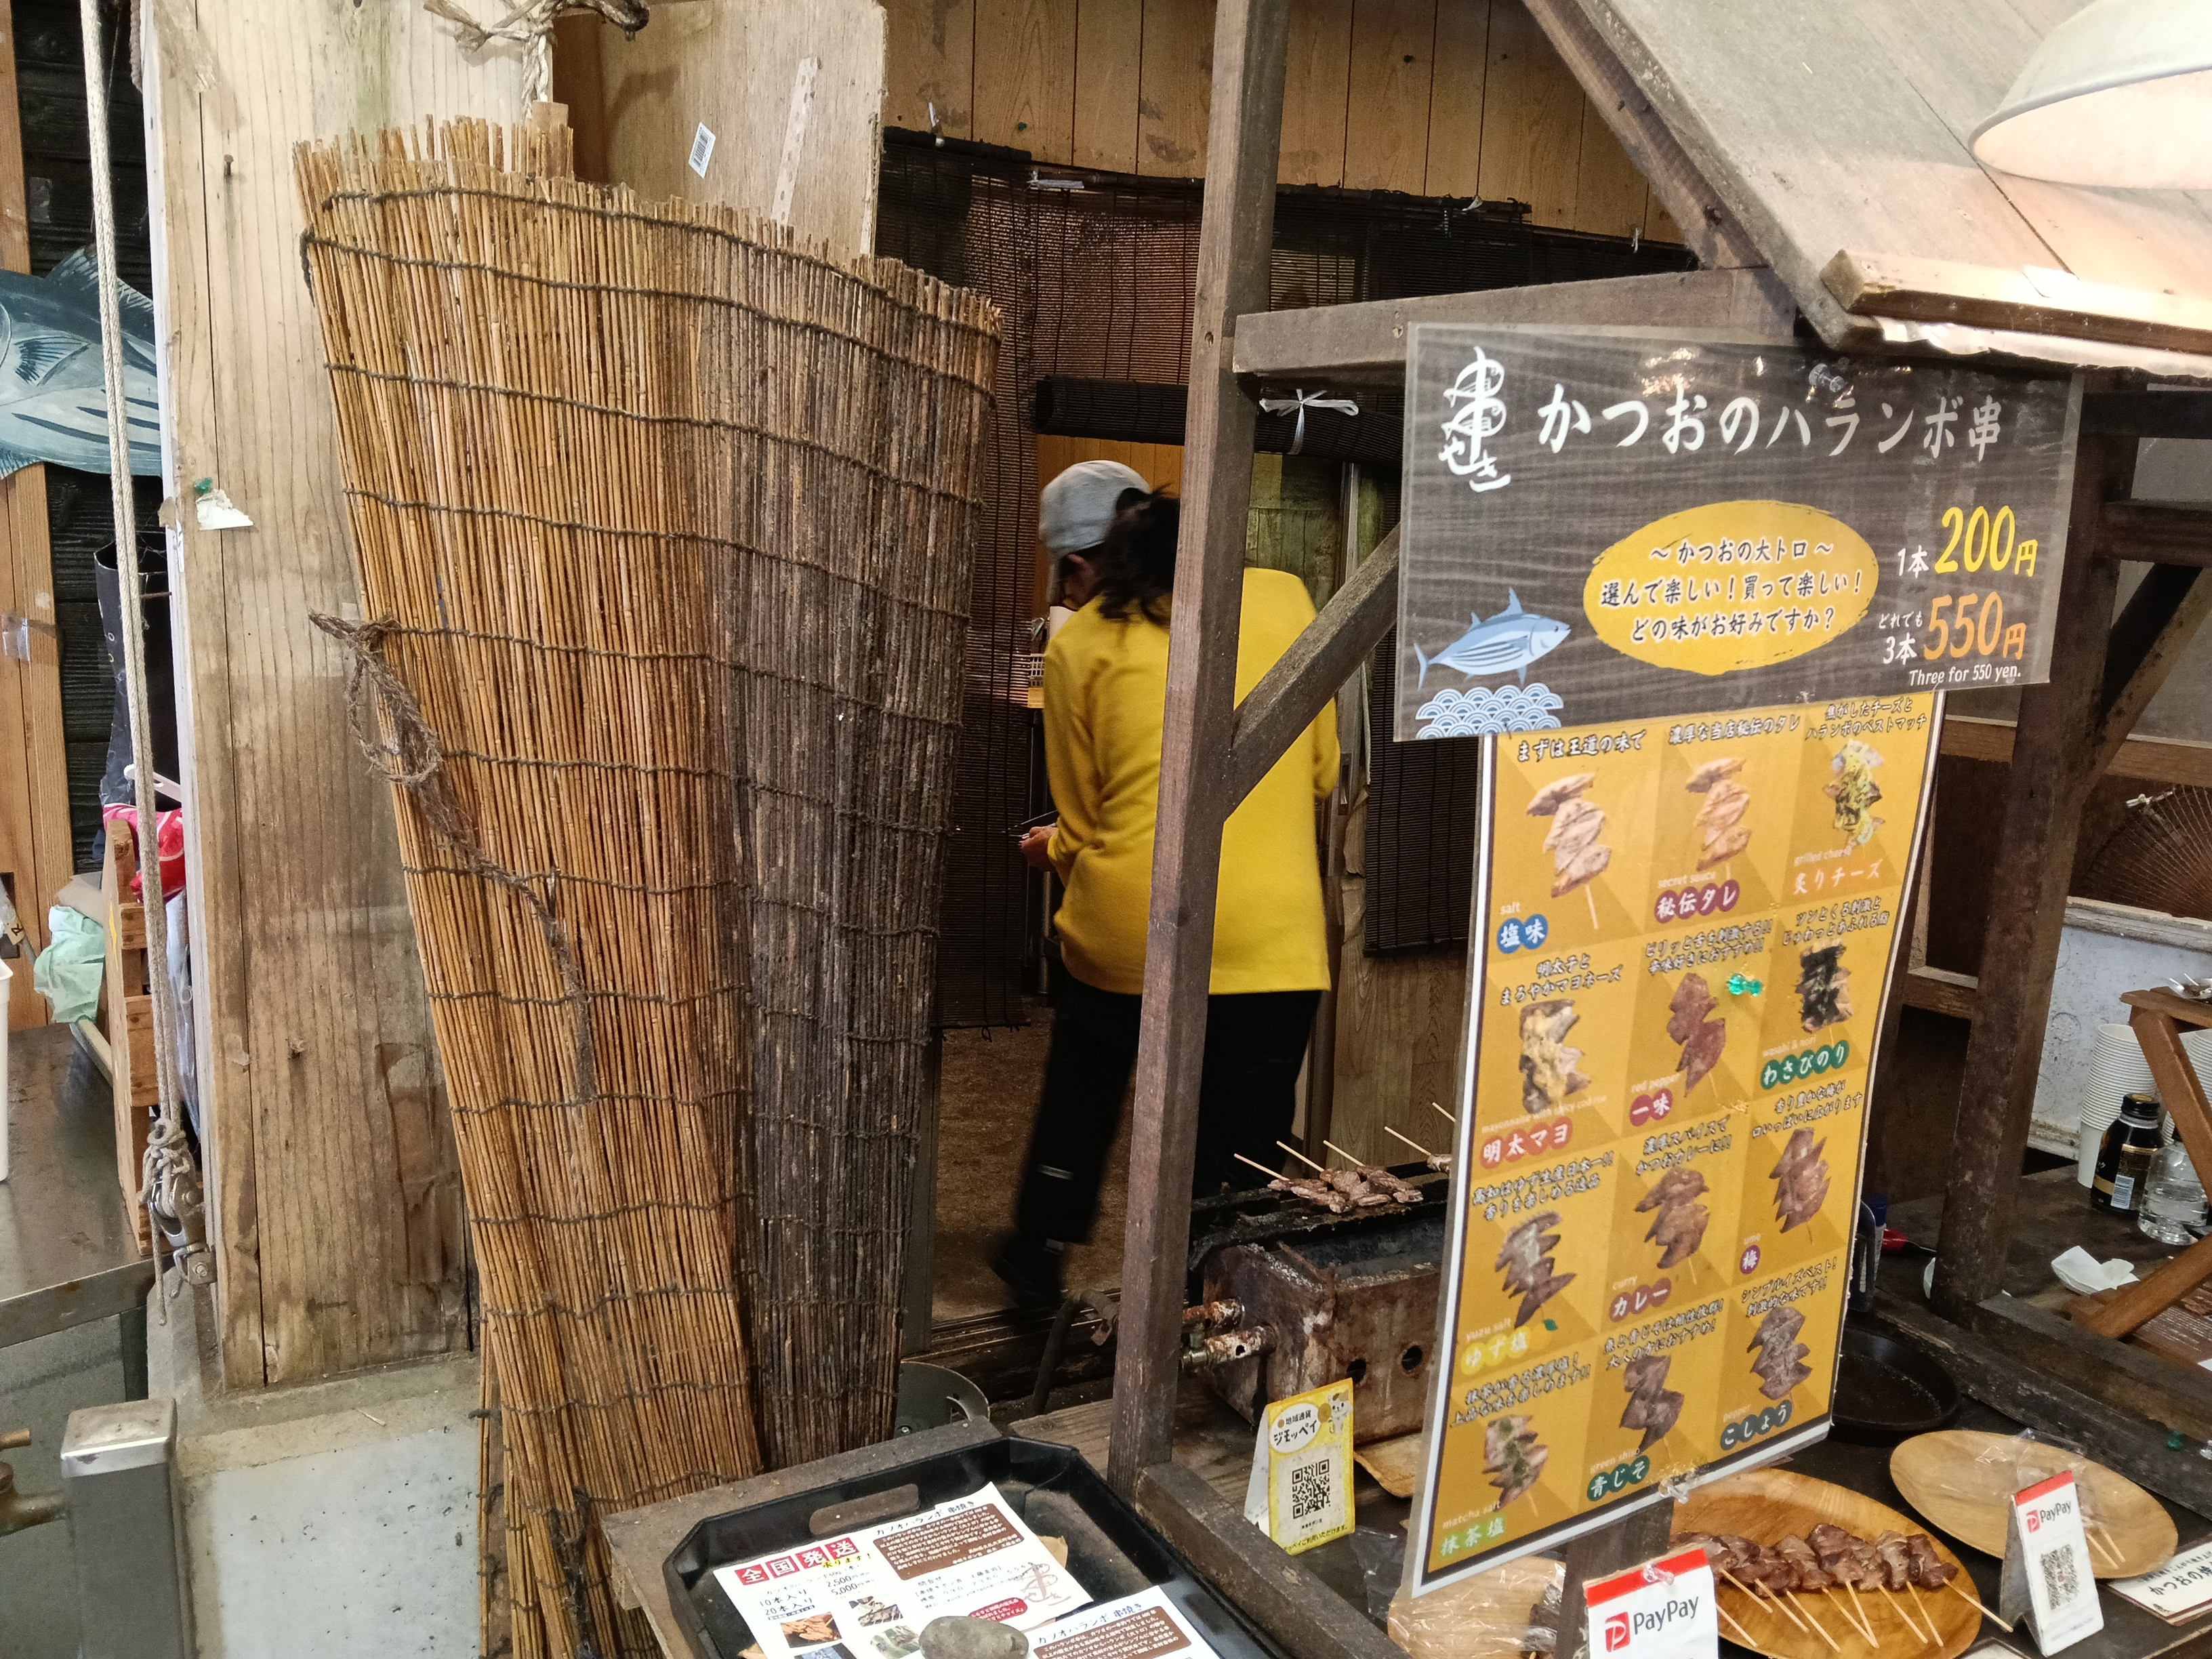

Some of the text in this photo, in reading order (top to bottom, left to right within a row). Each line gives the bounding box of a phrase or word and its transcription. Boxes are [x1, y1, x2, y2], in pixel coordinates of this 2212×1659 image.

[1537, 383, 2002, 462] かつおのハランボ串
[1896, 506, 2039, 577] 1本 200円
[1878, 612, 1923, 630] どれでも
[1885, 592, 2025, 666] 3本 550円
[1908, 665, 2022, 687] Three for 550 yen.
[1824, 697, 1913, 721] 焦がしたチーズと
[1668, 714, 1802, 745] 濃厚な当店秘伝のタレ
[1804, 714, 1928, 741] ハランボのベストマッチ
[1517, 729, 1647, 763] まずは王道の味で
[1793, 858, 1884, 896] 炙りチーズ
[1500, 901, 1521, 915] salt
[1656, 883, 1738, 918] 秘伝タレ
[1796, 895, 1883, 926] ツンとくる刺激と
[1498, 916, 1548, 949] 塩味
[1782, 910, 1891, 947] じゅわっとあふれる脂
[1536, 952, 1591, 979] 明太子と
[1500, 963, 1624, 1006] まろやかマヨネーズ
[1763, 1042, 1845, 1083] わさびのり
[1631, 1092, 1671, 1117] 一味
[1774, 1079, 1847, 1116] 香り豊かな梅が
[1750, 1092, 1864, 1139] 口いっぱいに広がります
[1482, 1122, 1570, 1164] 明太マヨ
[1742, 1233, 1761, 1246] ume
[1742, 1248, 1759, 1270] 梅
[1611, 1275, 1639, 1291] curry
[1612, 1287, 1669, 1317] カレー
[1465, 1325, 1492, 1343] yuzu
[1722, 1404, 1751, 1424] pepper
[1724, 1403, 1789, 1446] こしょう
[1273, 1419, 1318, 1446] ジモッペイ
[1590, 1459, 1646, 1499] 青じそ
[2039, 1500, 2072, 1523] PayPay
[1439, 1515, 1506, 1557] 抹茶塩
[741, 1539, 857, 1584] 全国発送
[759, 1588, 807, 1607] 10本入り
[764, 1597, 813, 1616] 20本入り
[1633, 1595, 1700, 1635] PayPay
